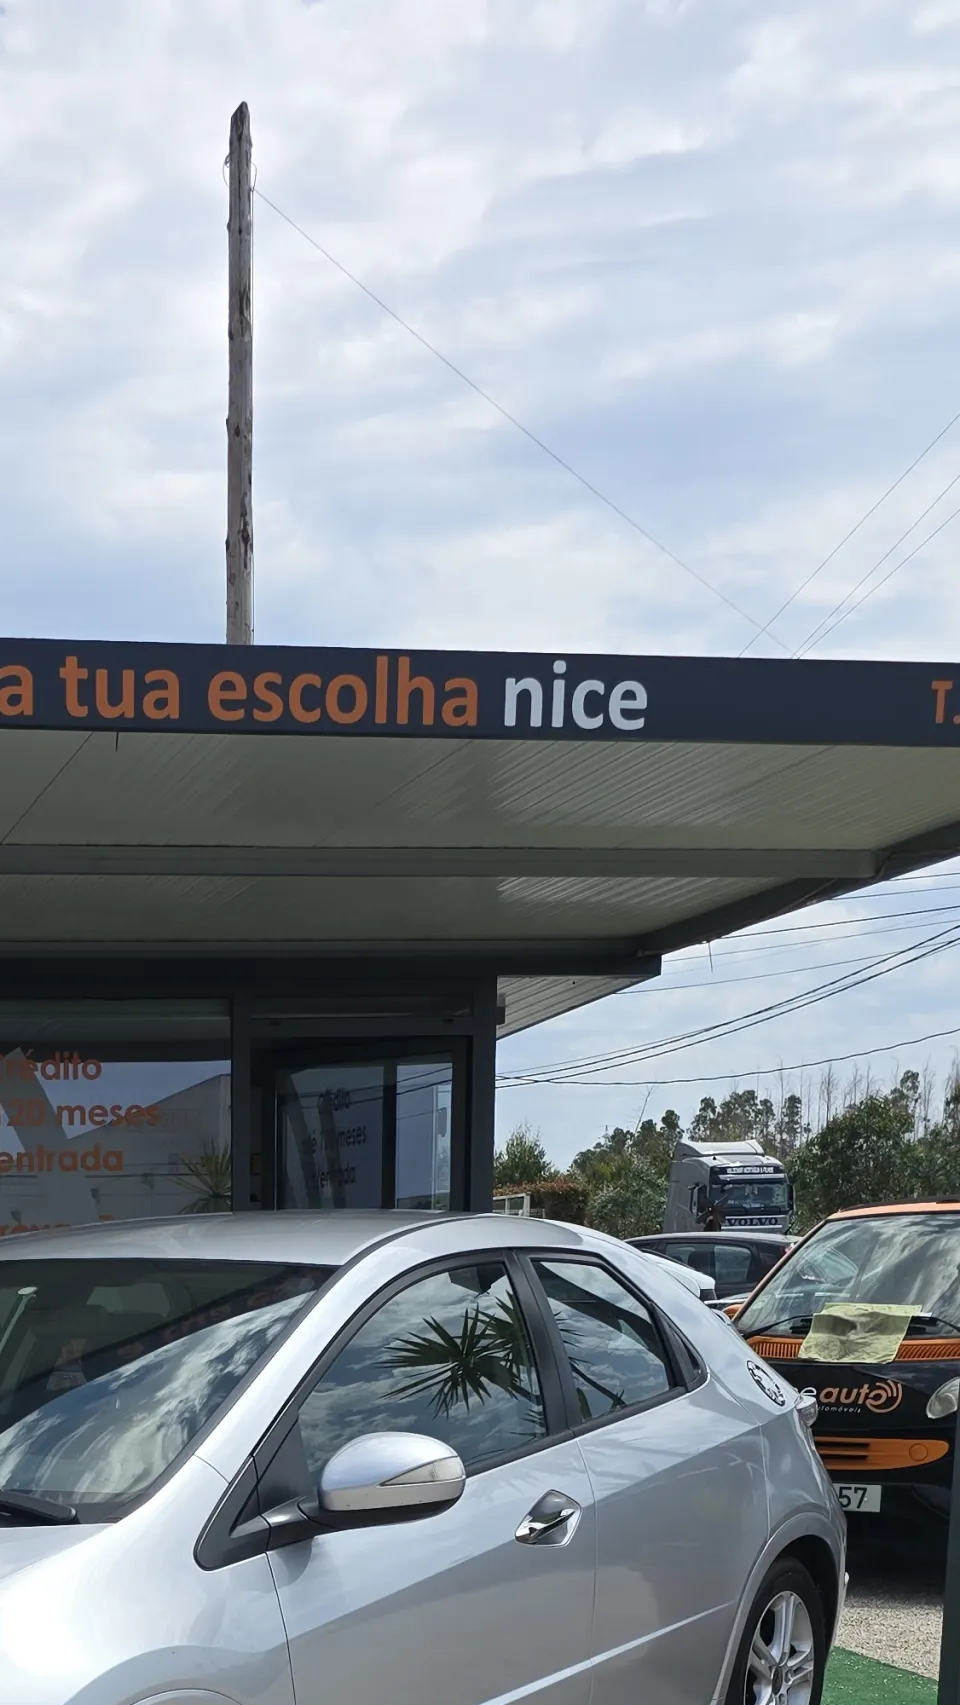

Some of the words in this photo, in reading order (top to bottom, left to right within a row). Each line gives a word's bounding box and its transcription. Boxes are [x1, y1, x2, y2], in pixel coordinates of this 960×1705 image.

[59, 655, 180, 720] tua
[207, 655, 479, 727] escolha
[503, 659, 649, 731] nice
[56, 1103, 161, 1127] meses
[726, 1217, 779, 1226] VOLVO
[838, 1486, 868, 1509] 57
